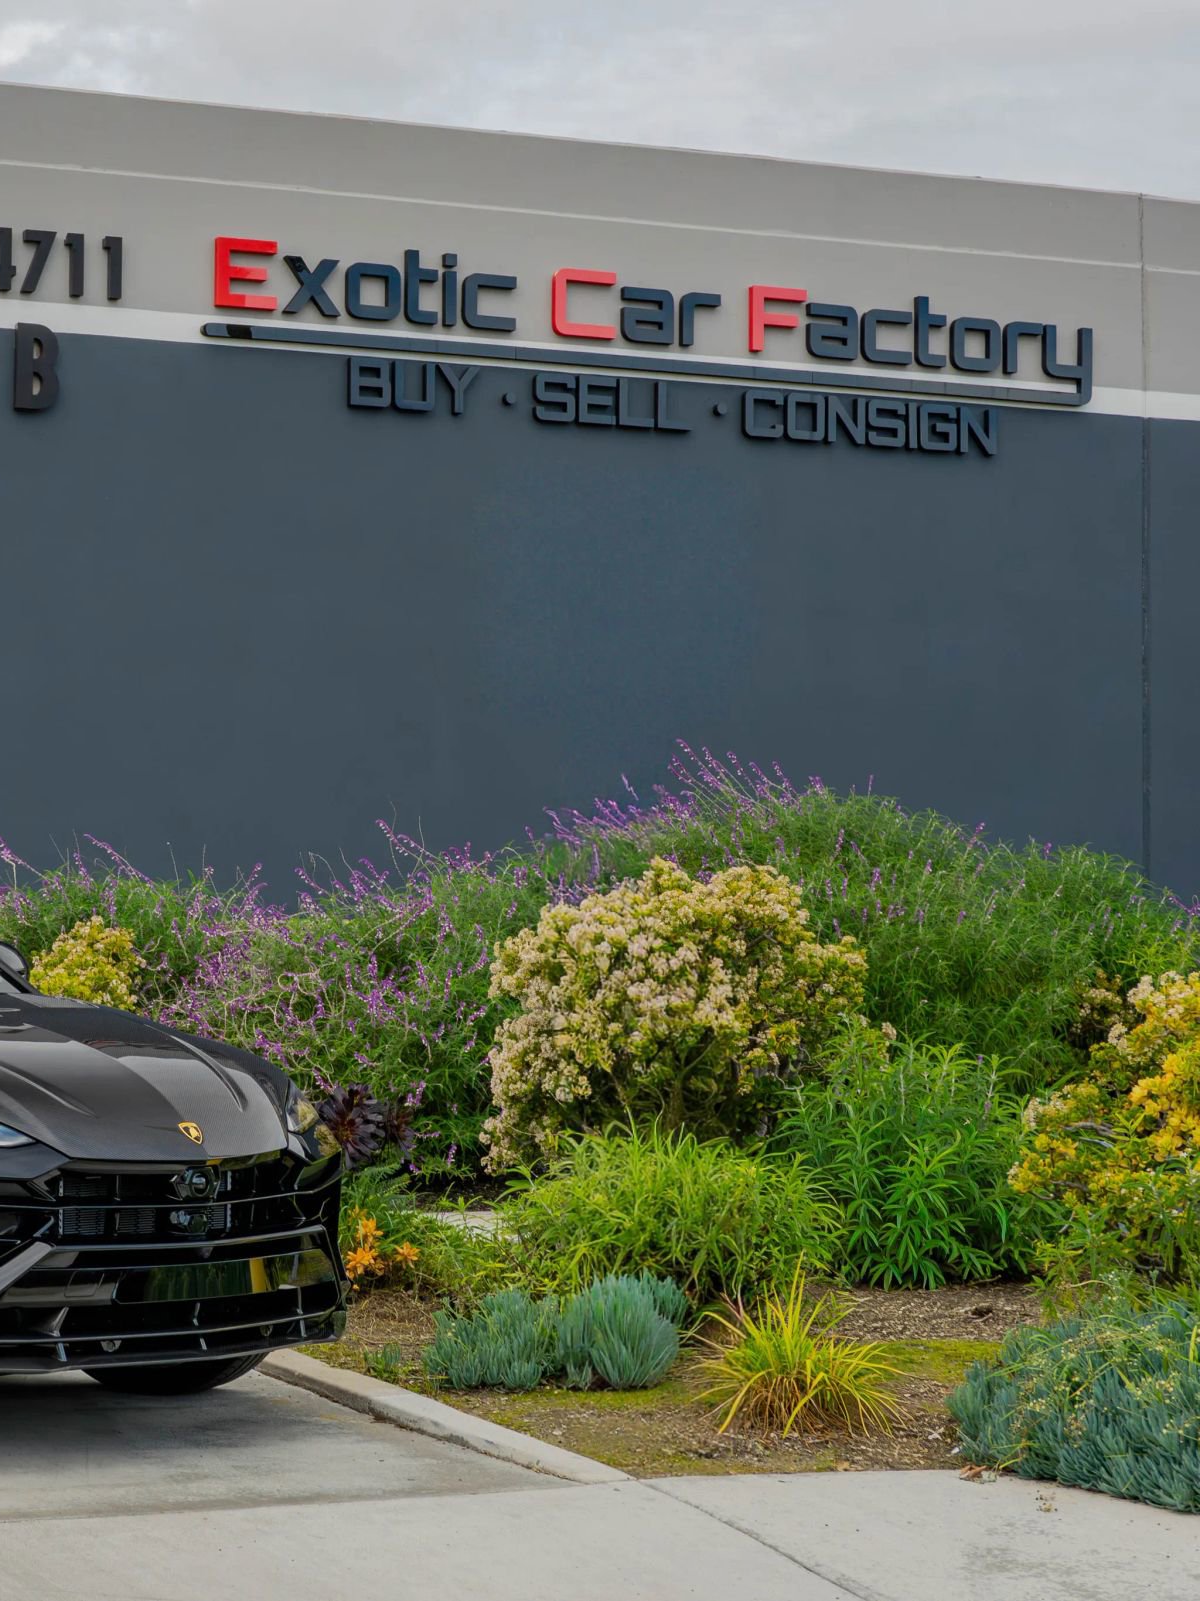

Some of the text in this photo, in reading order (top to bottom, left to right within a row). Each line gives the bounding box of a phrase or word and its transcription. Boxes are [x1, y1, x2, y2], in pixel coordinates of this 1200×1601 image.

[13, 322, 60, 412] B
[213, 236, 1094, 406] Exotic Car Factory
[347, 356, 999, 456] BUY SELL CONSIGN
